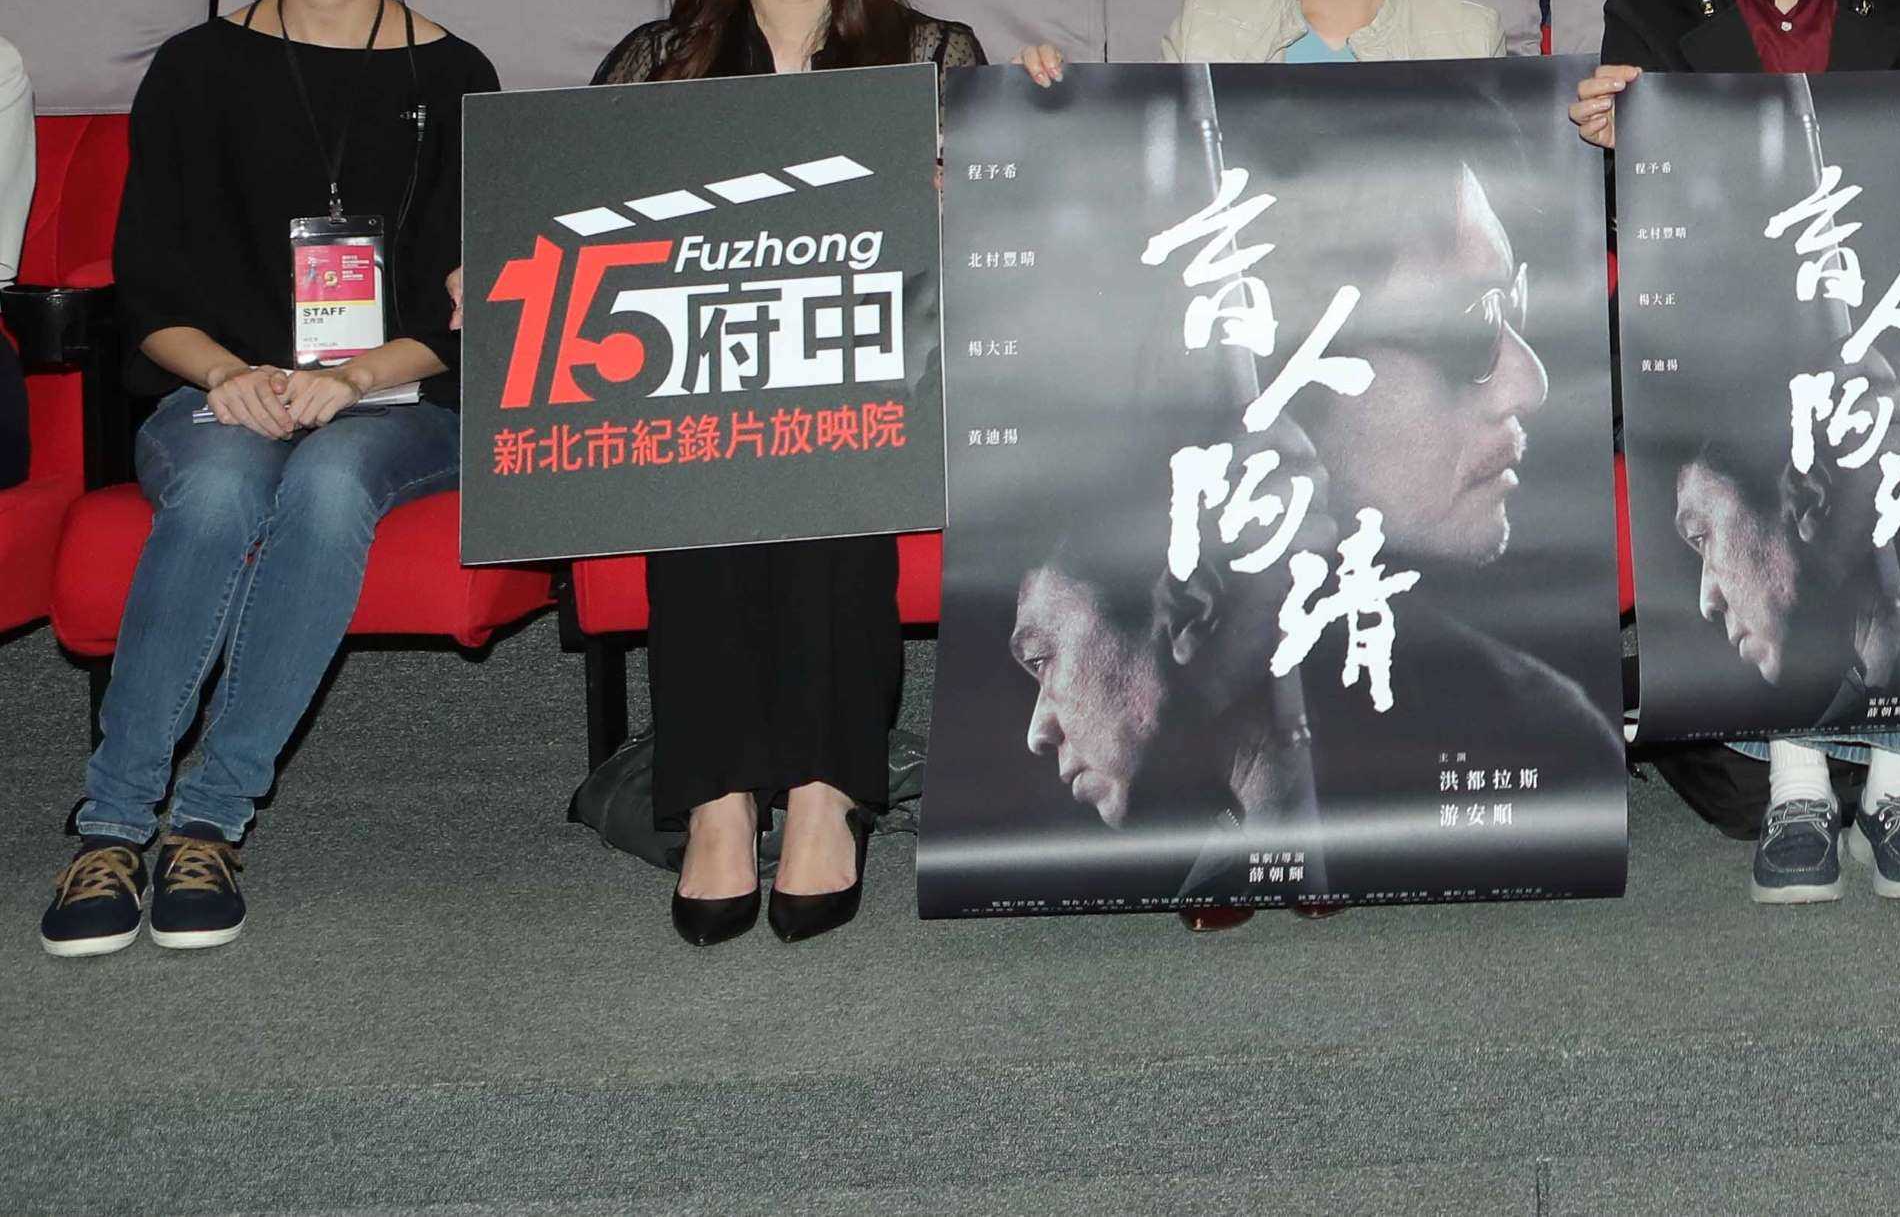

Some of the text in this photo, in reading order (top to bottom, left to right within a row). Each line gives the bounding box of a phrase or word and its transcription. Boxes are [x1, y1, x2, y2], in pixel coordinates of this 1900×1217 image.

[967, 163, 1018, 180] 程予希
[674, 231, 883, 273] Fuzhong
[303, 306, 346, 317] STAFF
[487, 234, 674, 408] 15
[968, 340, 1019, 356] 楊大正
[493, 401, 907, 476] 新北市紀錄片放映院
[1440, 768, 1538, 791] 洪都拉斯
[1440, 803, 1513, 826] 游安順
